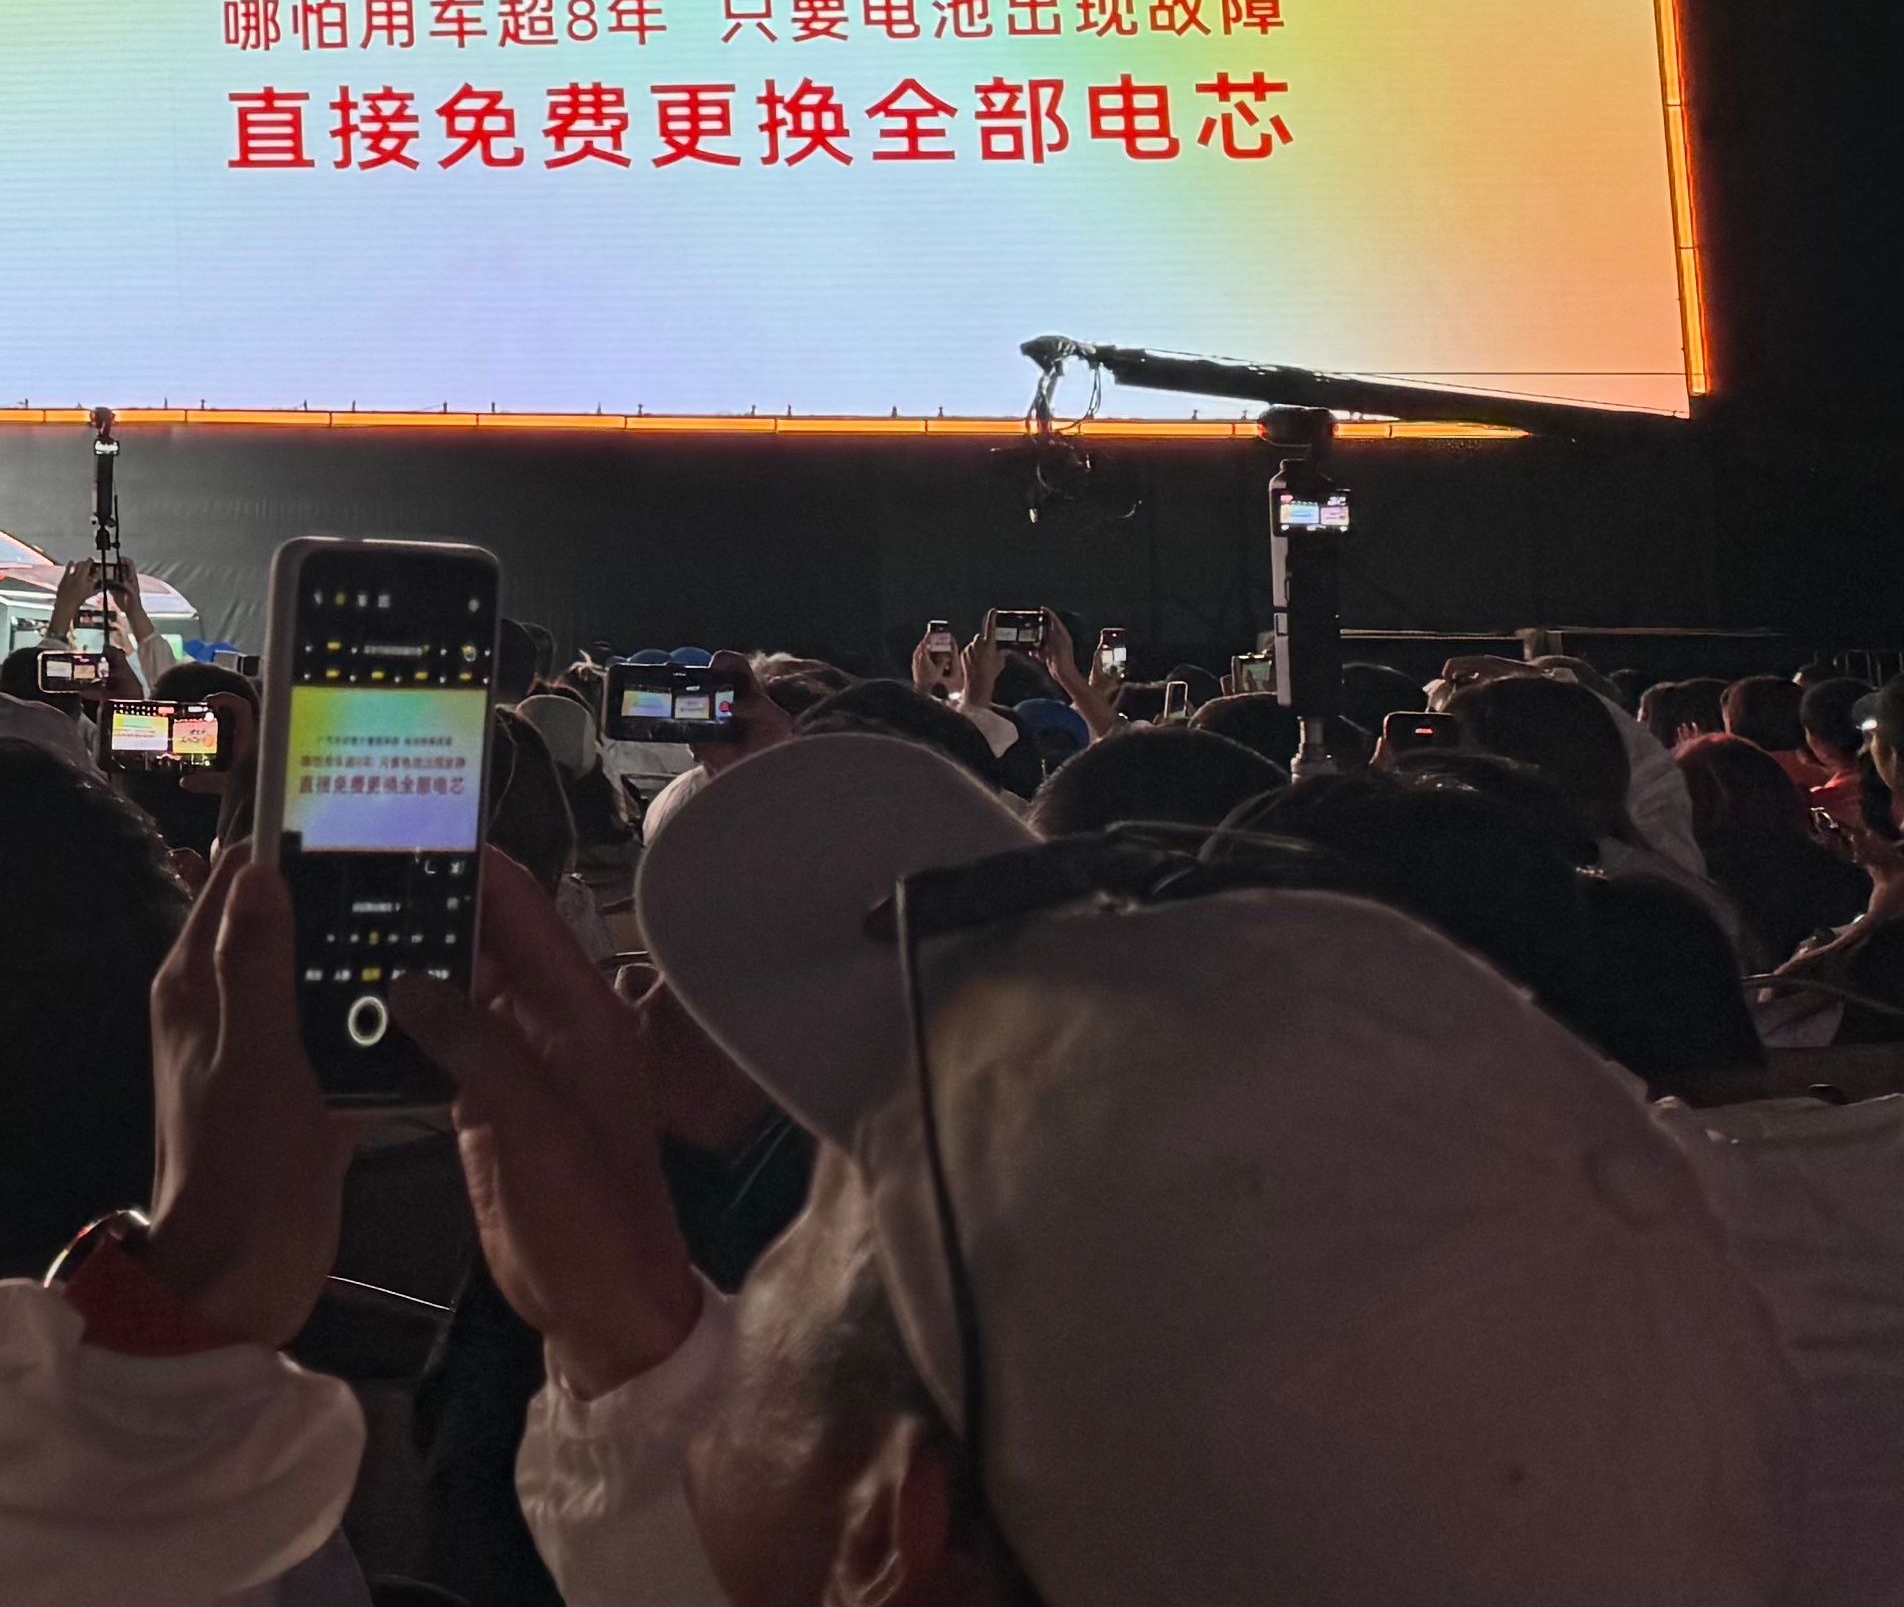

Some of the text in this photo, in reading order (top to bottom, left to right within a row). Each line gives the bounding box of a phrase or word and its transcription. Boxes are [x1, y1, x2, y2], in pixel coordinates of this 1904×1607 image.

[227, 71, 1295, 171] 直接免费更换全部电芯
